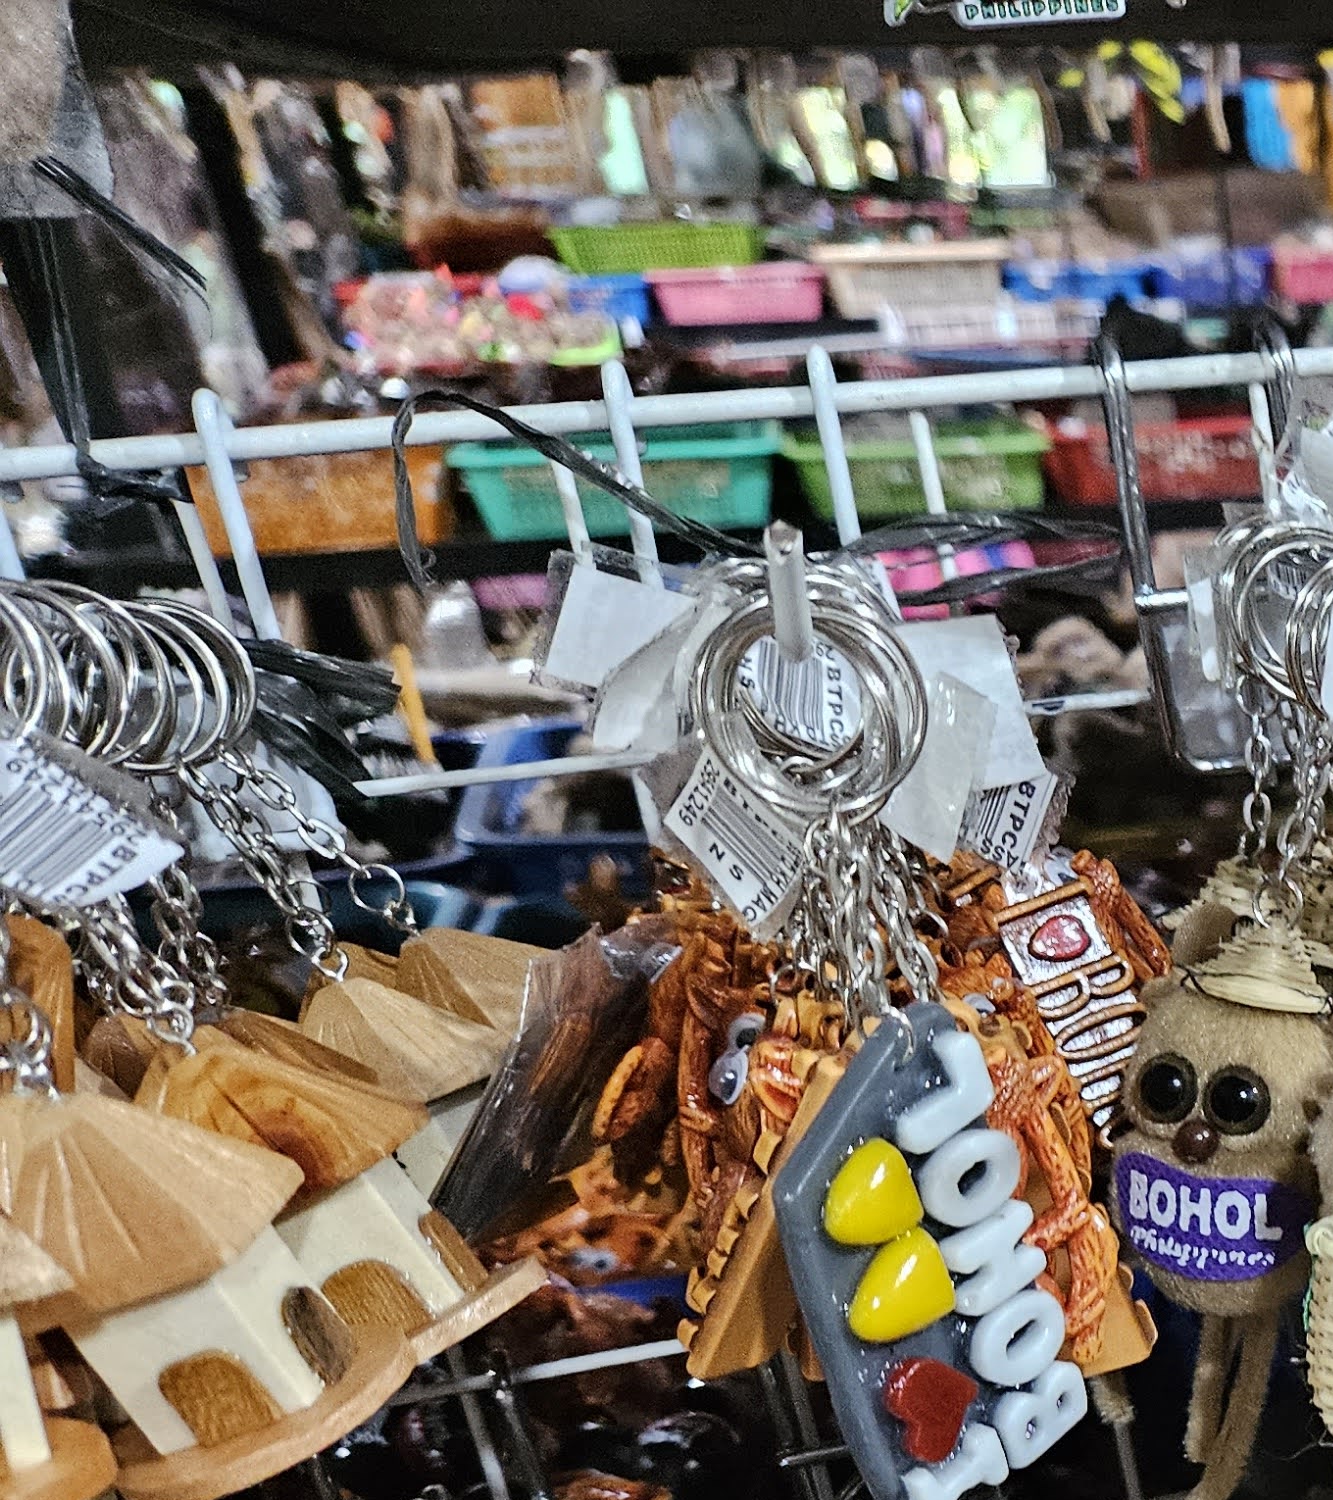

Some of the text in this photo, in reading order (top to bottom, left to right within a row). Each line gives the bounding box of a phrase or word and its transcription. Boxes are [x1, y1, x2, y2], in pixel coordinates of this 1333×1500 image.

[965, 0, 1119, 20] PHILIPPINES
[677, 757, 722, 828] 29541249
[1001, 780, 1036, 849] BTPC
[66, 844, 138, 896] BTPC
[708, 841, 745, 882] N S
[1129, 1168, 1284, 1243] BOHOL
[895, 1030, 1088, 1471] BOHOL
